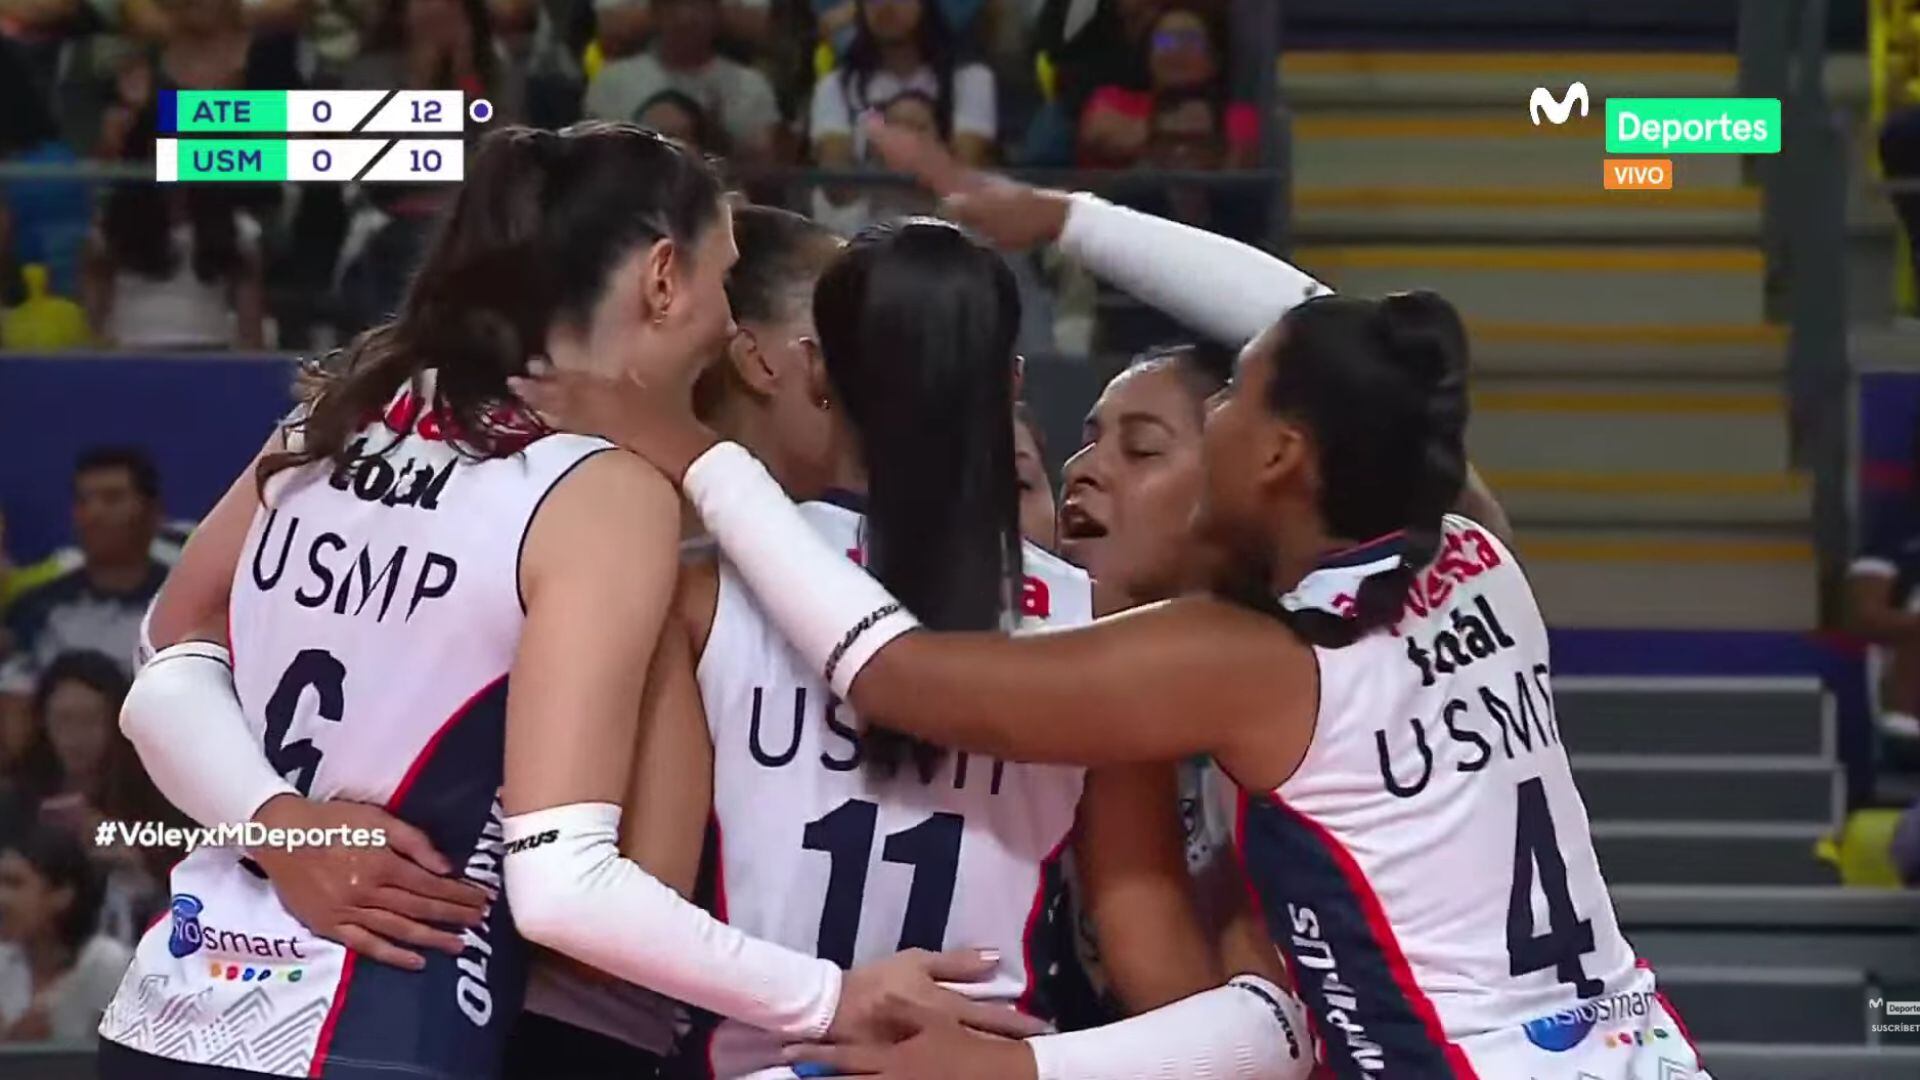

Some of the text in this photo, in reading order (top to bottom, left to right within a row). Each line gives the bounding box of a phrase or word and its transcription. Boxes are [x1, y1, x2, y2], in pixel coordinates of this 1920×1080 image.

[252, 508, 458, 623] USMP
[1405, 594, 1516, 687] total
[802, 798, 965, 970] 11
[1506, 776, 1605, 999] 4
